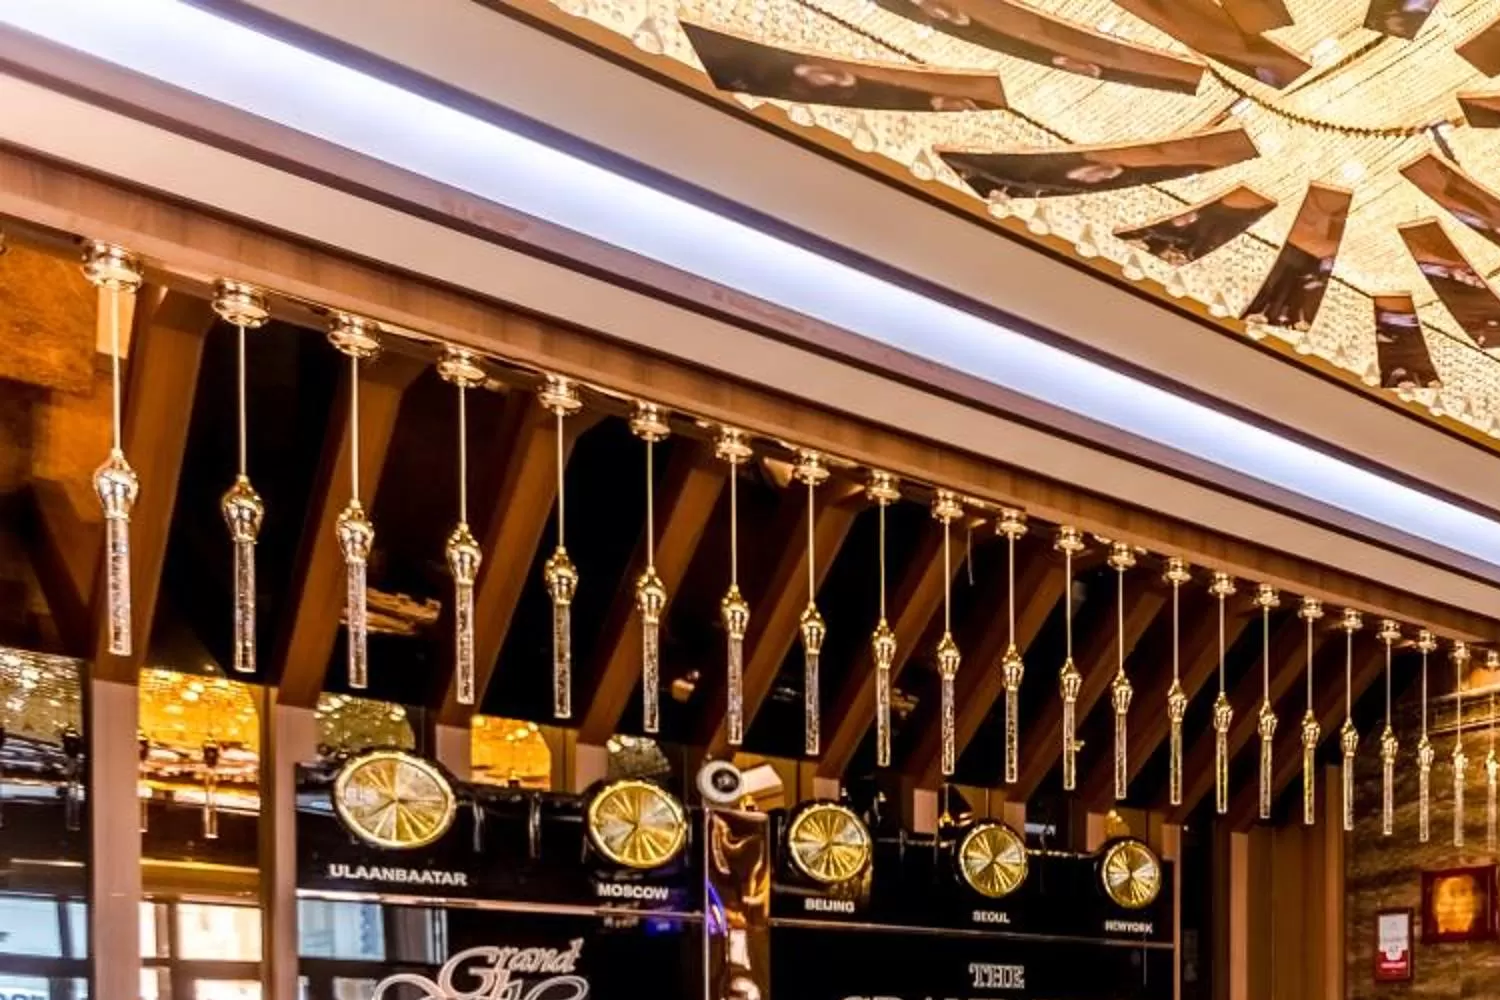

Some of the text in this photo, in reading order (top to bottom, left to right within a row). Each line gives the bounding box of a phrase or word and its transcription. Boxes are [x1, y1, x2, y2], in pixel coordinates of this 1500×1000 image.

[329, 864, 467, 886] ULAANBAATAR
[597, 882, 669, 900] MOSCOW
[804, 897, 855, 913] BEIJING
[972, 911, 1010, 923] SEOUL
[969, 963, 1025, 989] THE
